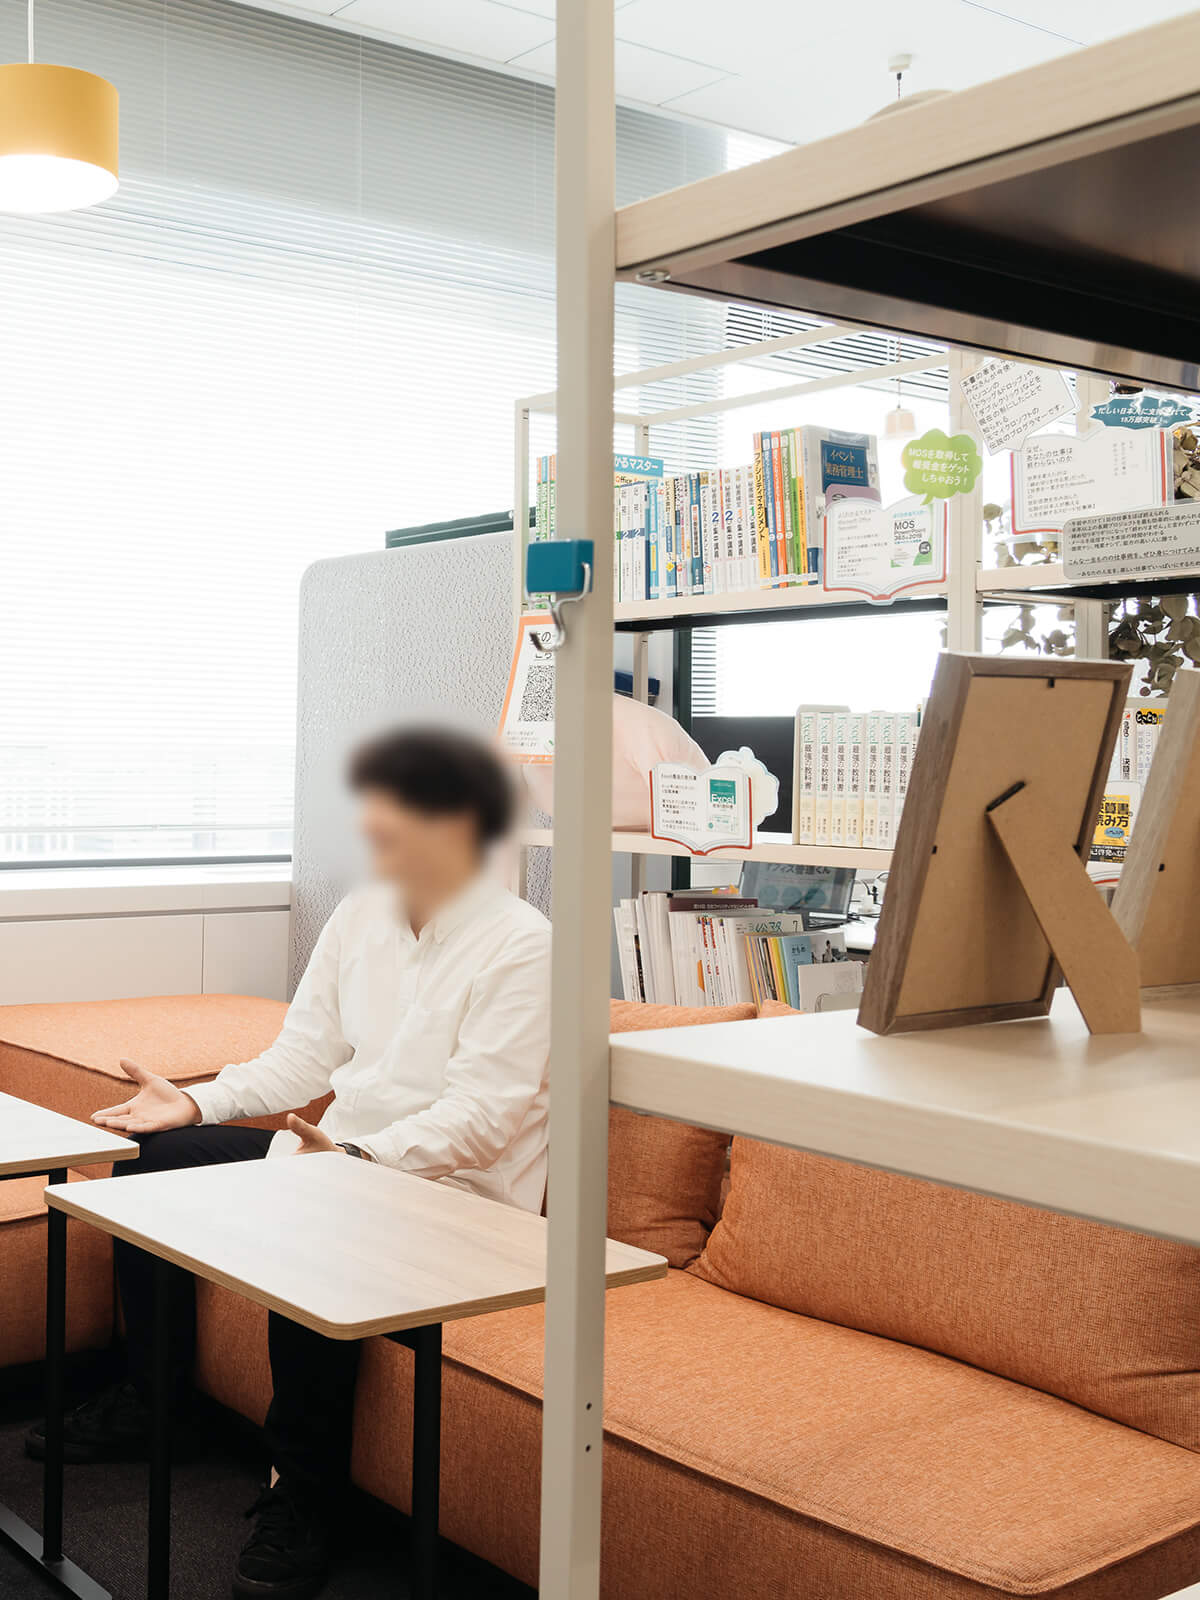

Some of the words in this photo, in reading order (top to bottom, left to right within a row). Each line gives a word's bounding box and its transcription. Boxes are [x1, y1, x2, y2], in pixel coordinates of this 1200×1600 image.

[831, 449, 855, 461] イベント
[908, 447, 969, 462] MOSを取得して
[1026, 447, 1073, 461] あなたの仕事は
[825, 463, 864, 479] 業務管理士
[894, 520, 915, 530] MOS
[712, 793, 735, 805] Excel
